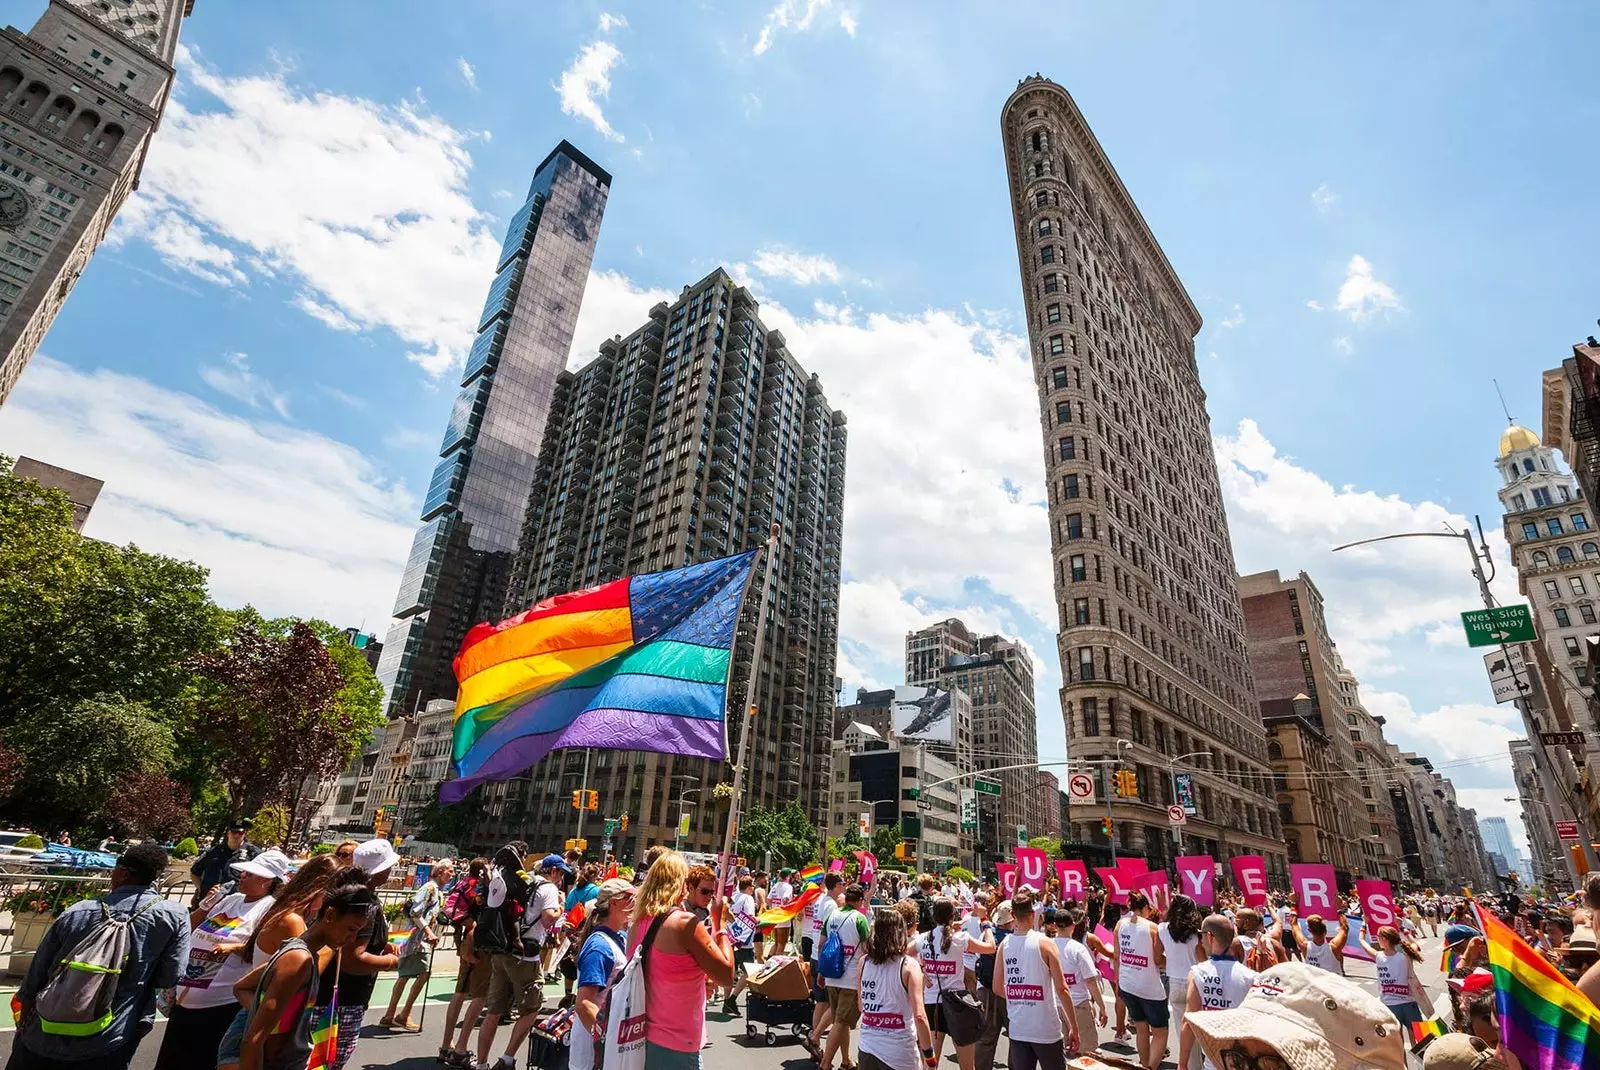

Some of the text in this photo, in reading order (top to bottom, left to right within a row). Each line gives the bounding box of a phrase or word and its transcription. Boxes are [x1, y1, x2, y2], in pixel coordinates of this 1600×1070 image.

[1499, 608, 1525, 618] Side
[1473, 619, 1524, 631] Highway
[1495, 685, 1514, 696] LOCAL
[1546, 734, 1582, 744] W 23 St
[863, 856, 874, 874] A
[1023, 856, 1042, 880] U
[1063, 869, 1082, 893] R
[1108, 874, 1130, 895] L
[1184, 869, 1208, 895] Y
[1242, 868, 1265, 895] E
[1301, 878, 1330, 908] R
[1367, 894, 1393, 925] S
[1005, 957, 1017, 965] we
[861, 980, 876, 989] we
[1203, 976, 1221, 984] we
[1008, 985, 1042, 998] lawyers
[1203, 986, 1223, 996] are
[862, 1003, 883, 1012] our
[1204, 997, 1232, 1007] your
